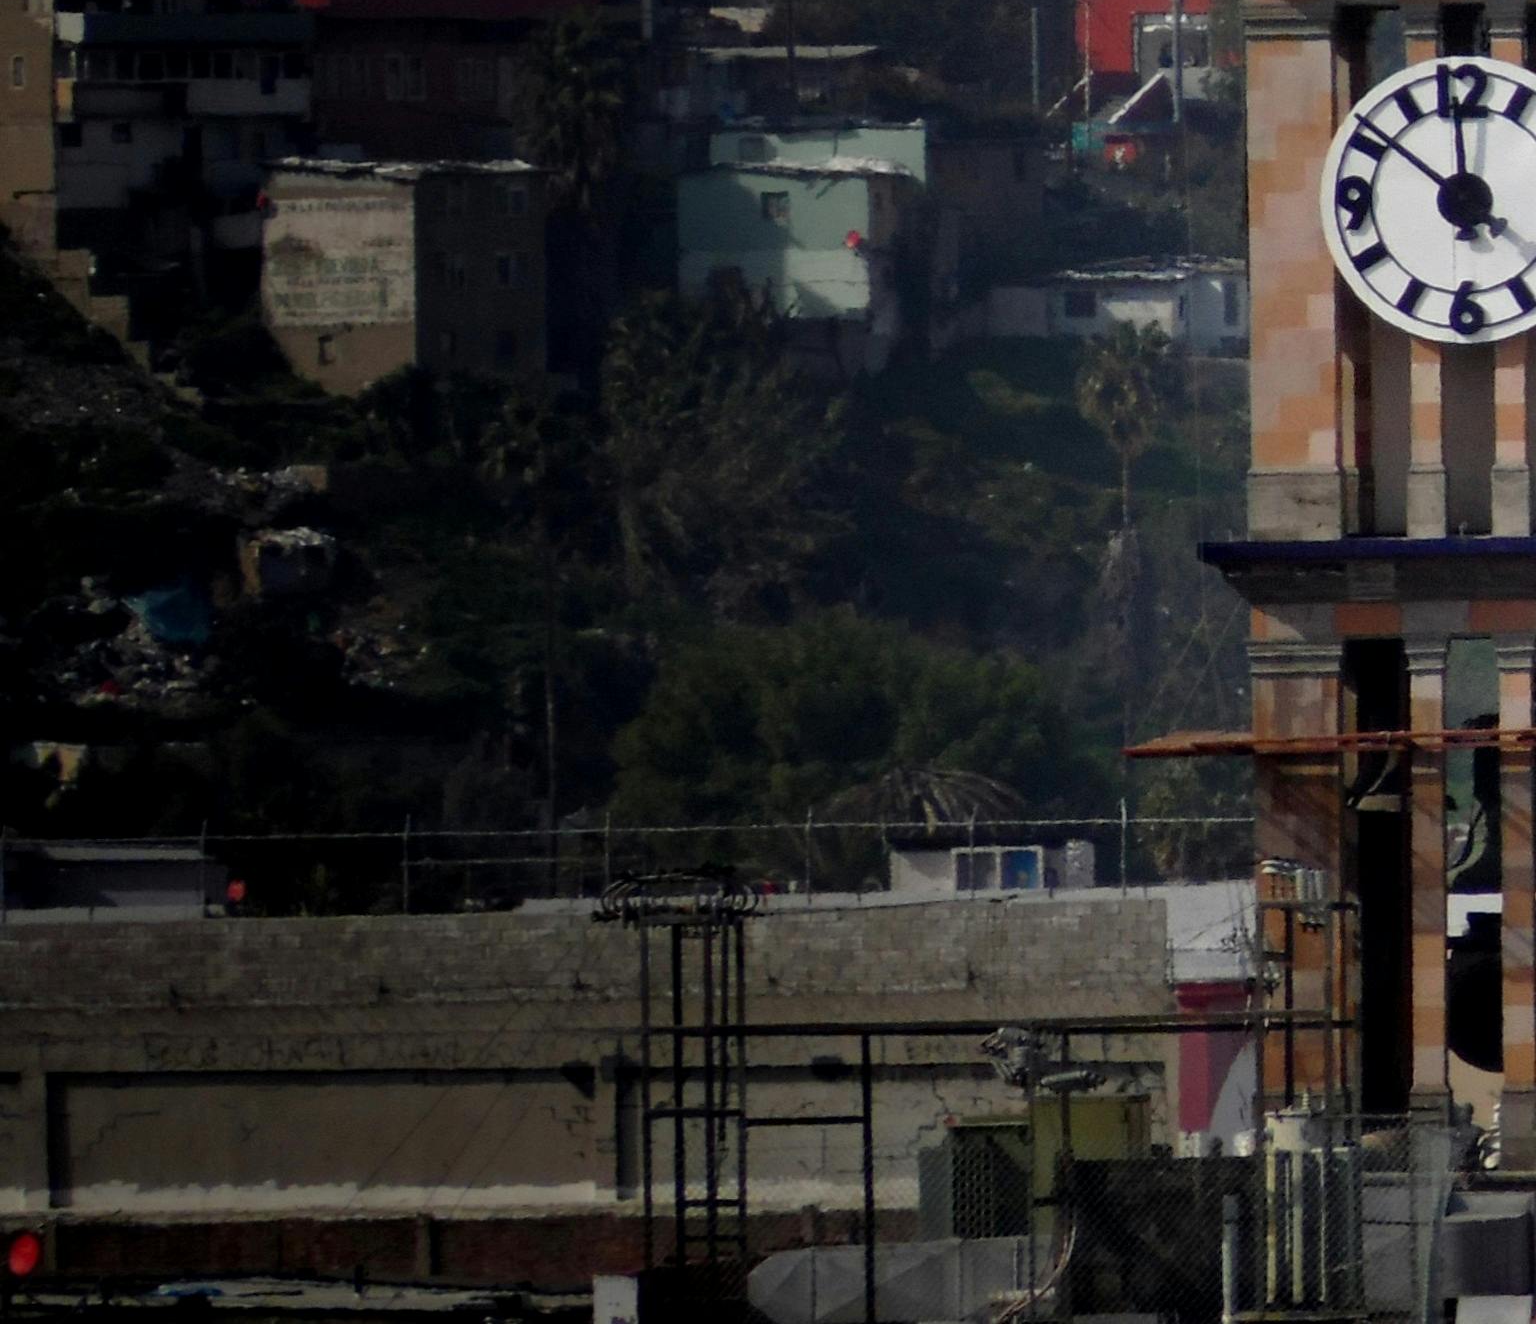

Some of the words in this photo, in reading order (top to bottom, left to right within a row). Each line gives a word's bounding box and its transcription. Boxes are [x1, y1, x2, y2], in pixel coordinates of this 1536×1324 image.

[1436, 64, 1489, 119] 12
[1337, 175, 1373, 231] 9
[1449, 280, 1486, 335] 6
